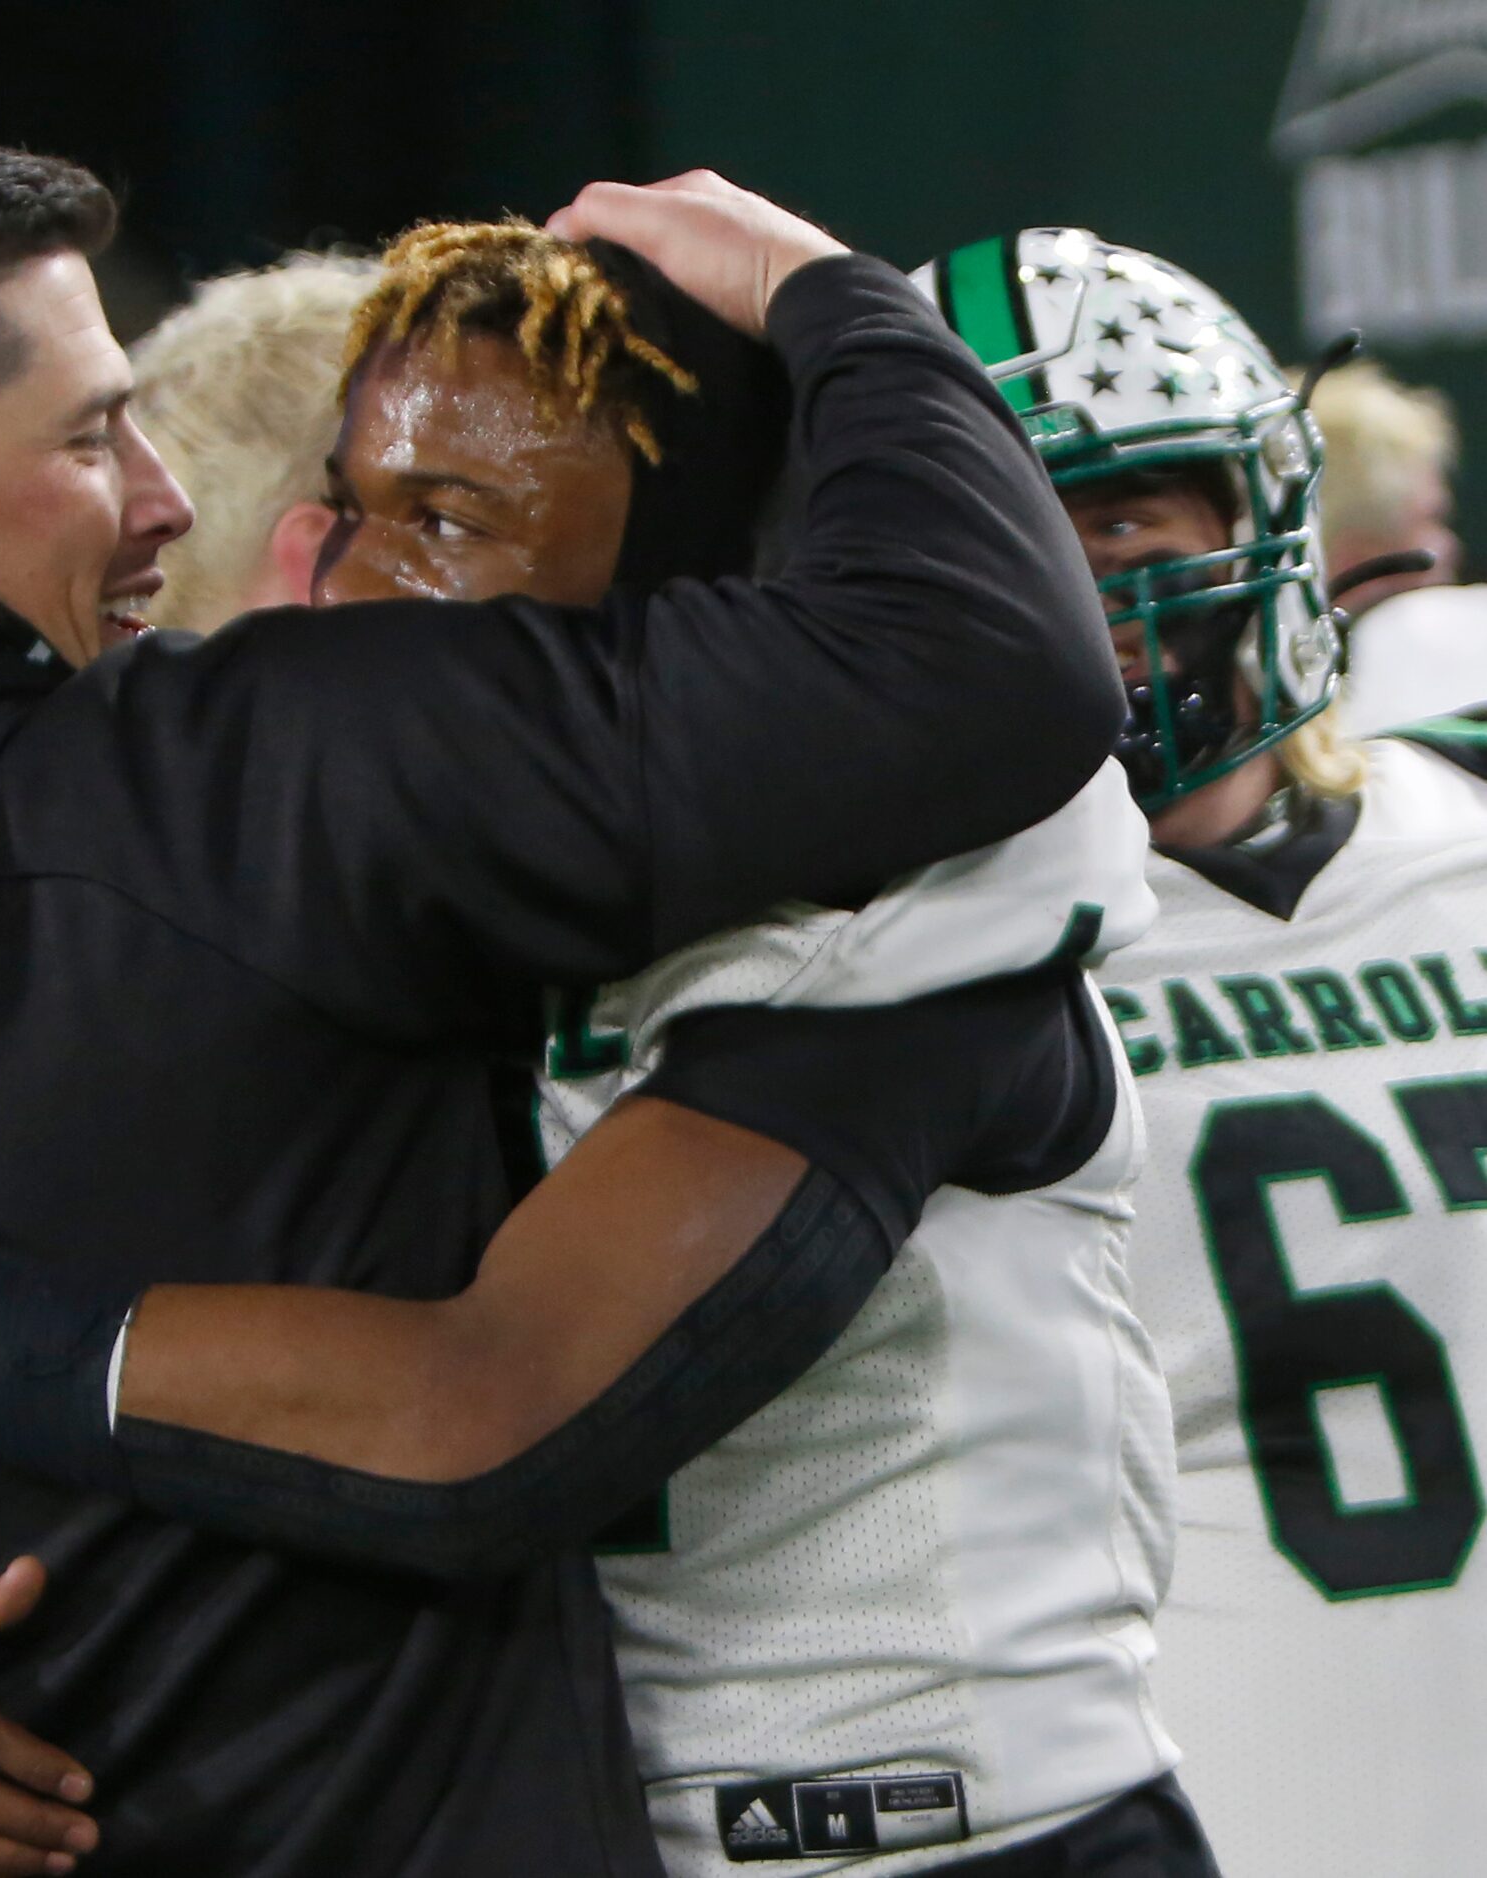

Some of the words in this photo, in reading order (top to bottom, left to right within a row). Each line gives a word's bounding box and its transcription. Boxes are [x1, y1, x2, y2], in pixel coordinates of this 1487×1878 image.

[1103, 945, 1487, 1077] CARROL
[726, 1825, 789, 1843] adidas
[826, 1811, 847, 1838] M
